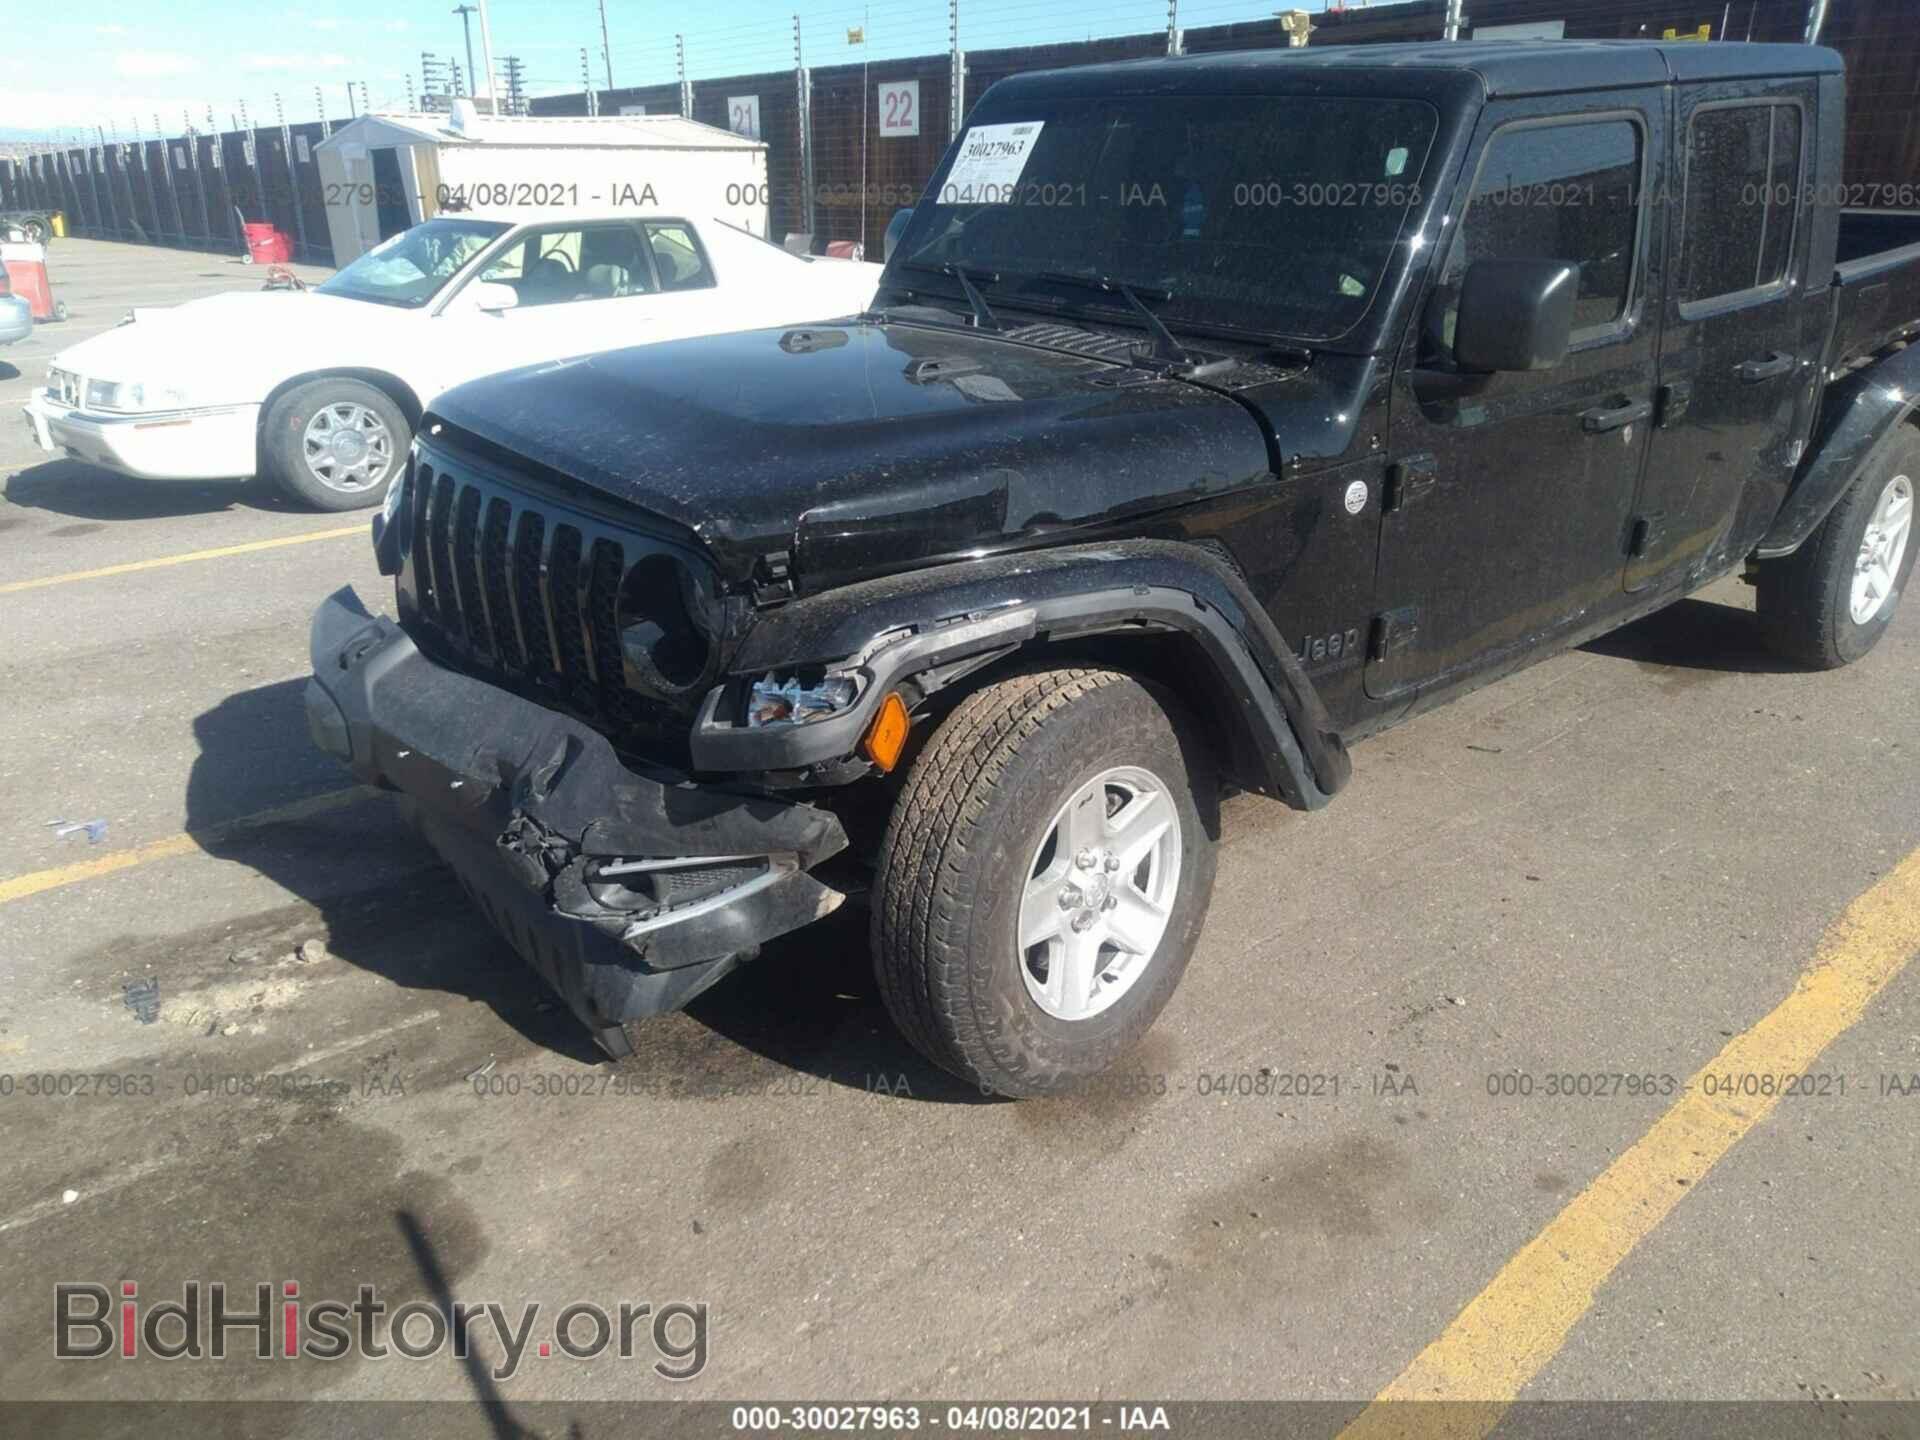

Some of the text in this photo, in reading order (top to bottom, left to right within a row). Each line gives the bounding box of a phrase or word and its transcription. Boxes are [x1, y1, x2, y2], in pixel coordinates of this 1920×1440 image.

[733, 103, 753, 136] 21
[885, 91, 913, 128] 22
[1297, 627, 1359, 662] Jeep
